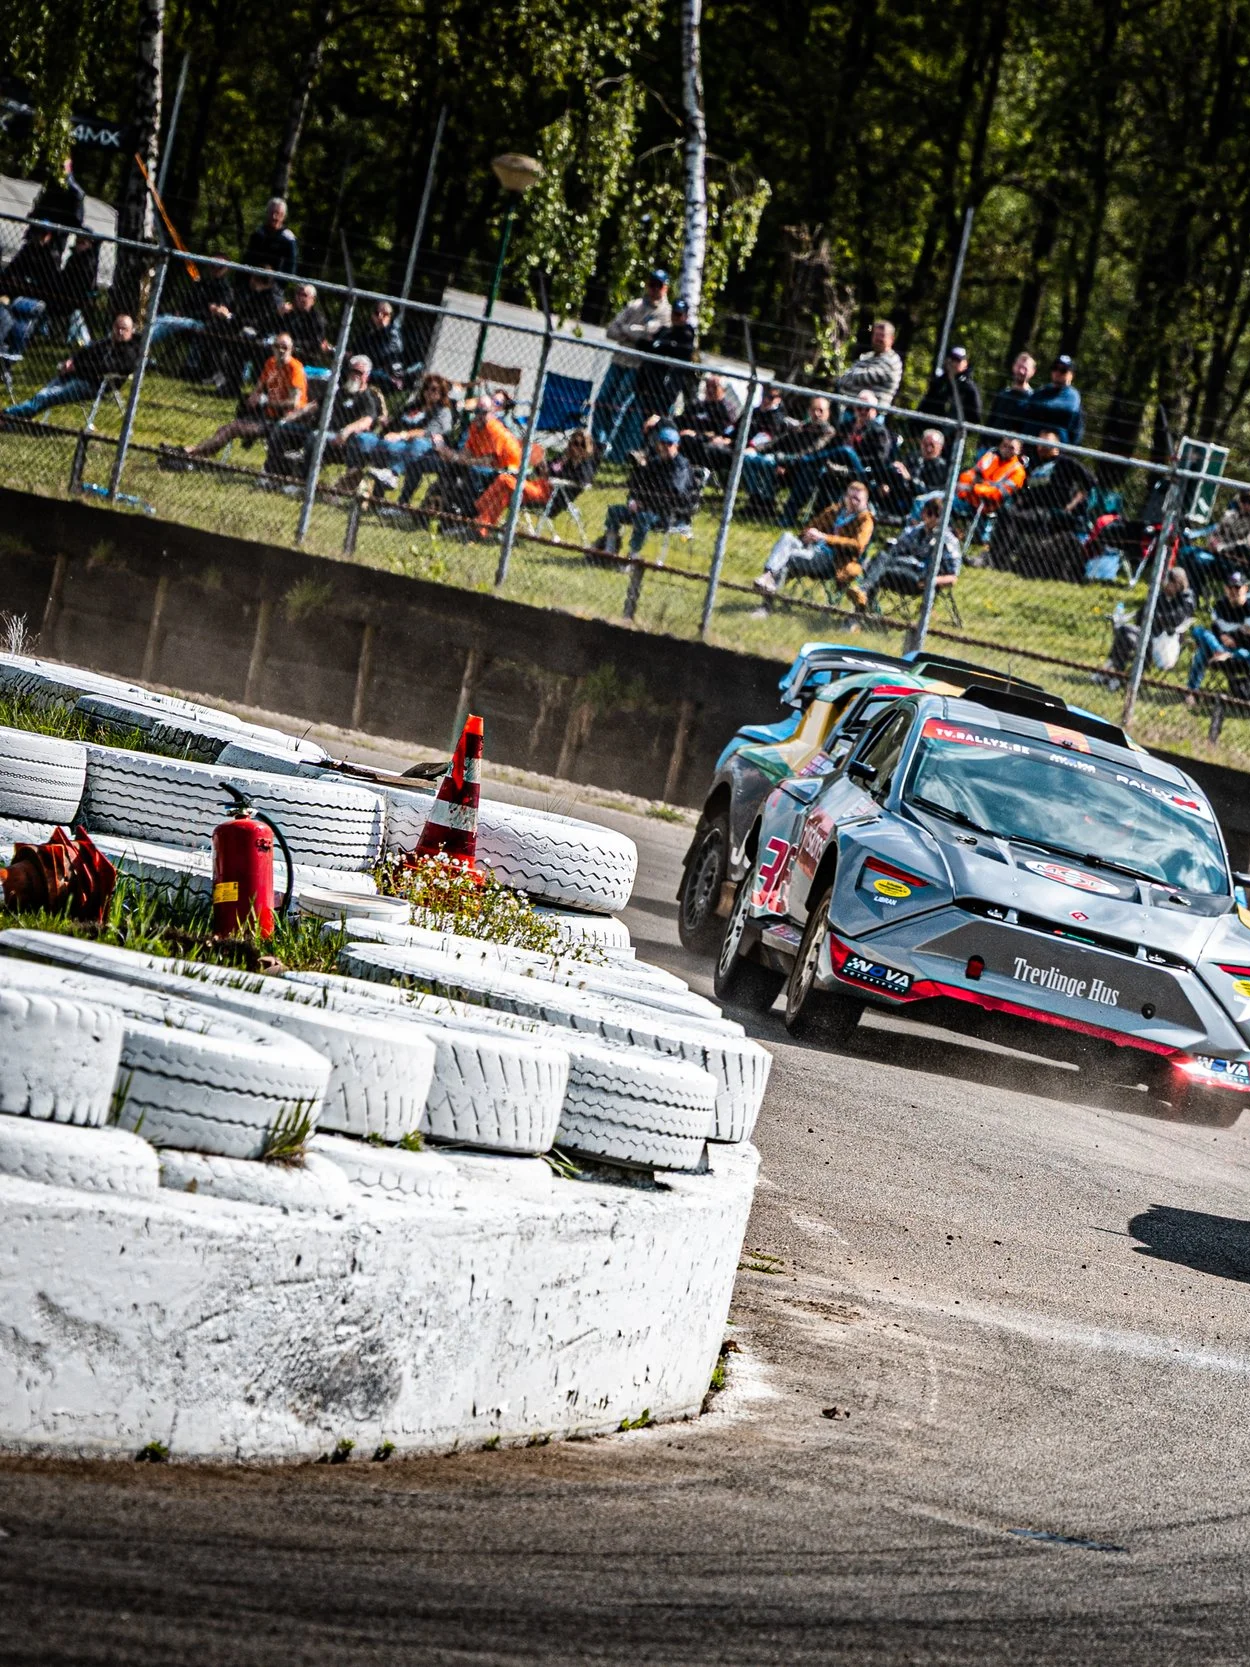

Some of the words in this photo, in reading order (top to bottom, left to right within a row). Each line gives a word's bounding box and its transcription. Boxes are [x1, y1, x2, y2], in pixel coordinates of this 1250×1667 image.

[936, 728, 1030, 755] TV.RALLYX.SE
[1013, 957, 1087, 998] Trevlinge
[1088, 978, 1120, 1007] Hus
